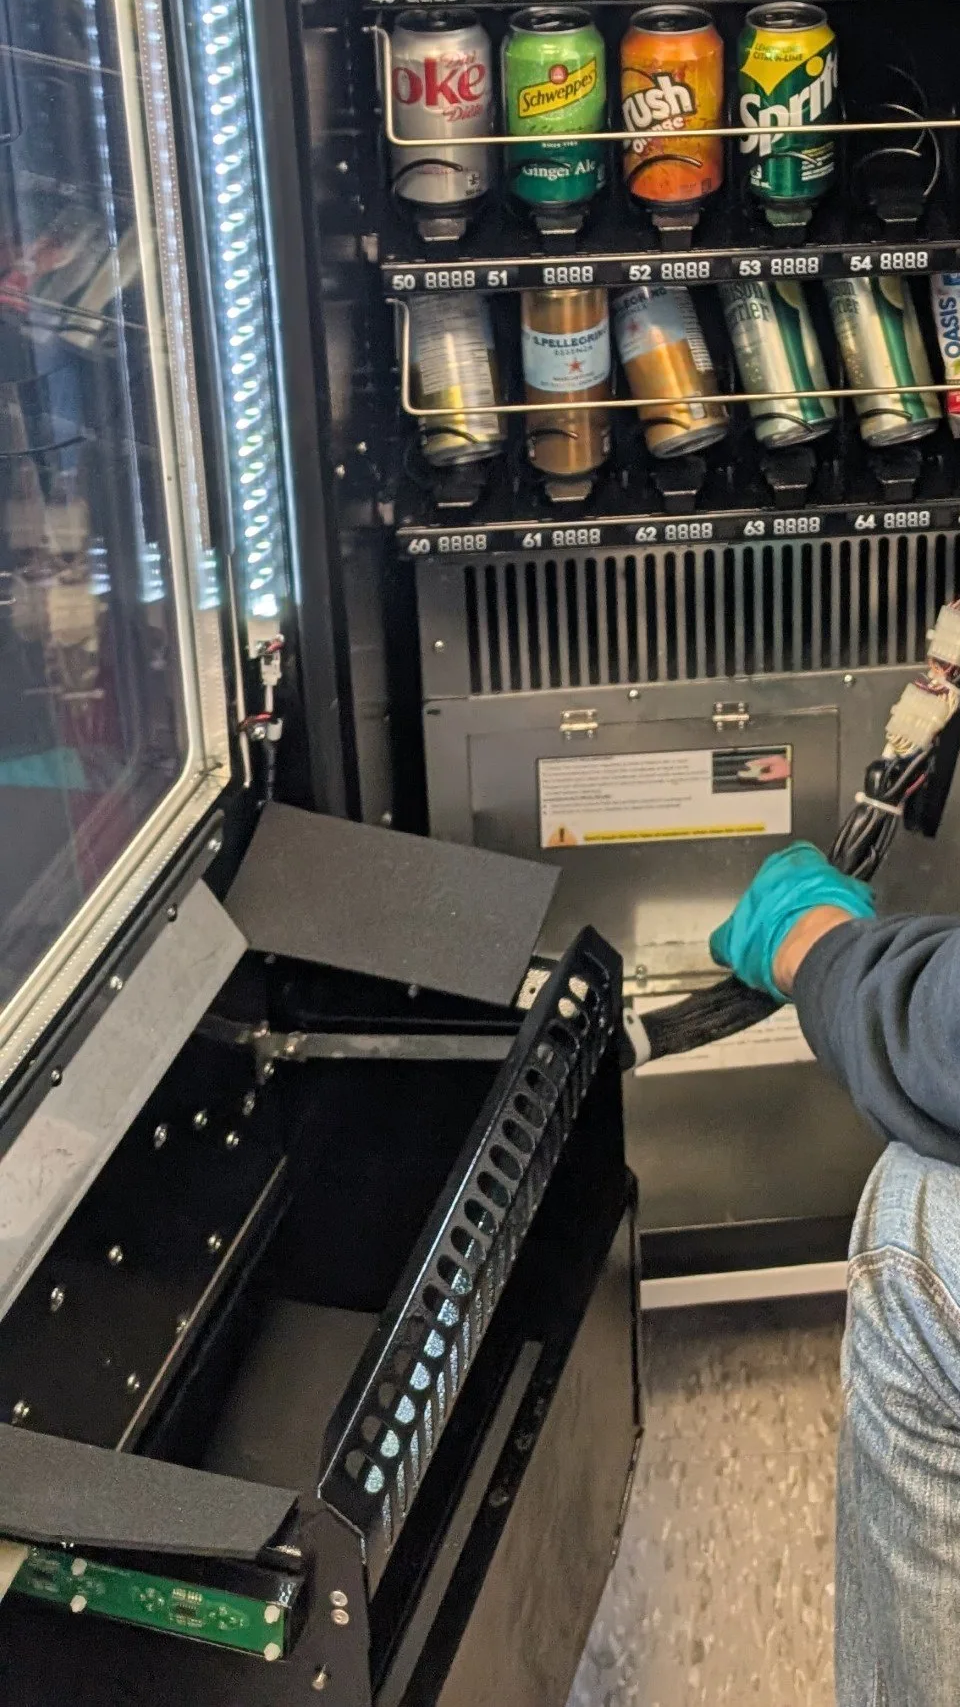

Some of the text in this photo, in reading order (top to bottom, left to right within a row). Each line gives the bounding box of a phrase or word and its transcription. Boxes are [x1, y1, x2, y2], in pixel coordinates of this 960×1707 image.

[392, 55, 486, 107] oke
[522, 73, 596, 112] Schweppes
[622, 74, 694, 133] rush
[739, 260, 762, 277] 53
[850, 256, 873, 272] 54
[487, 270, 508, 287] 51
[629, 265, 652, 282] 52
[392, 275, 416, 291] 50
[743, 521, 766, 536] 63
[854, 514, 876, 530] 64
[522, 532, 543, 548] 61
[635, 526, 657, 542] 62
[408, 539, 431, 555] 60
